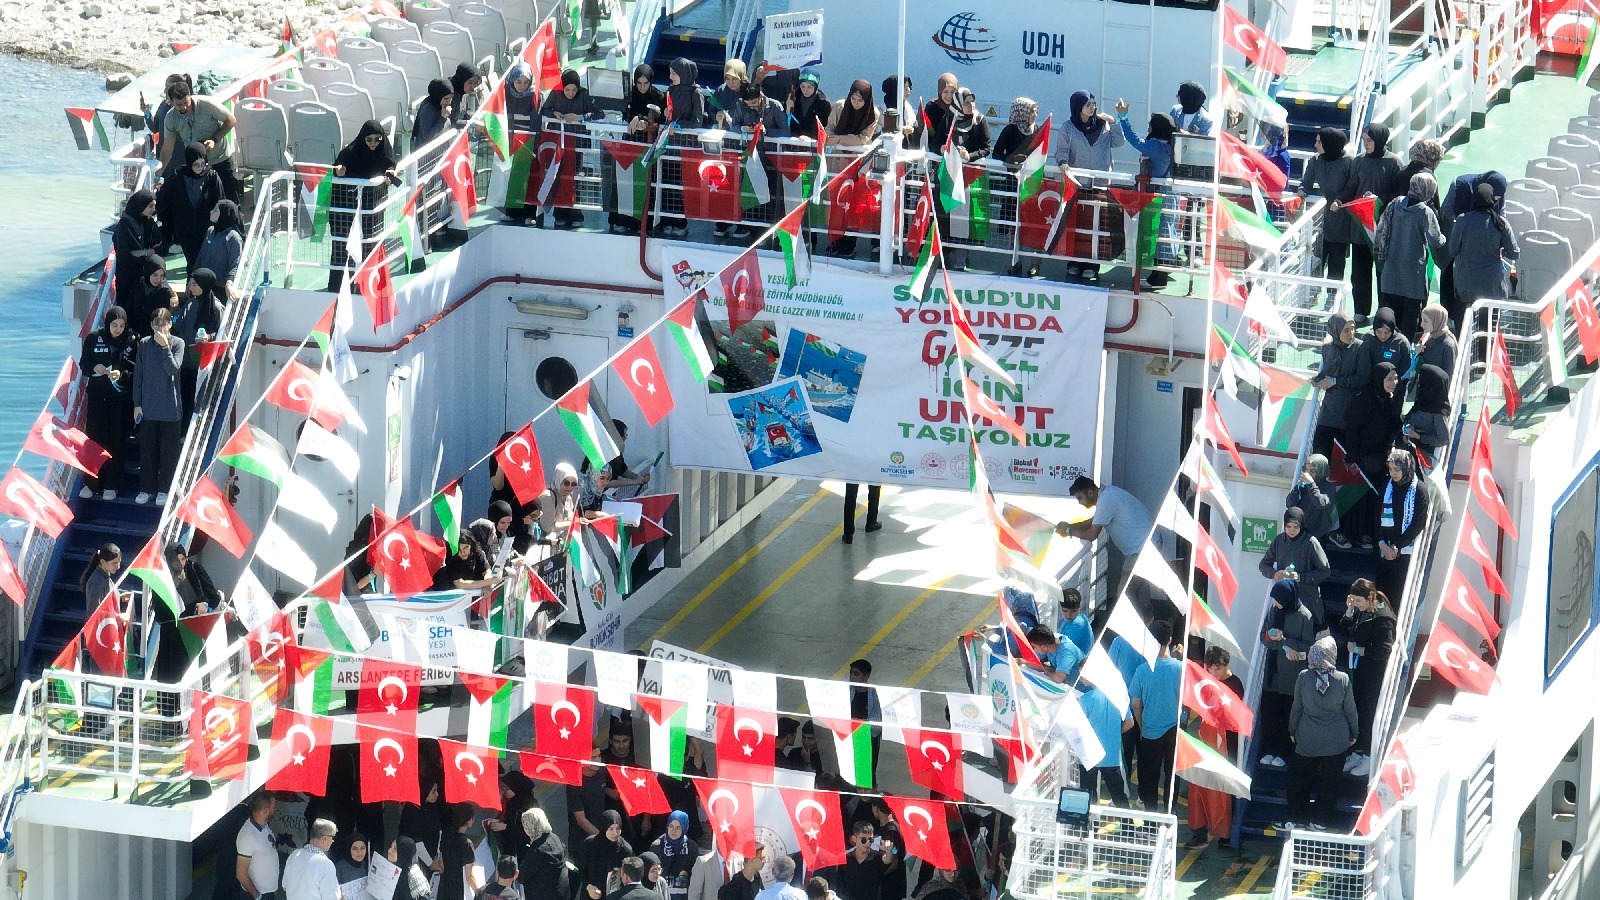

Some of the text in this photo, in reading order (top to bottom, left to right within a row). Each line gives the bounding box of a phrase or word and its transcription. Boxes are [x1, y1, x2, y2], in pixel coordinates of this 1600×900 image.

[1022, 31, 1064, 58] UDH
[1024, 59, 1063, 74] Bakanlığı
[822, 310, 856, 321] YANINDA
